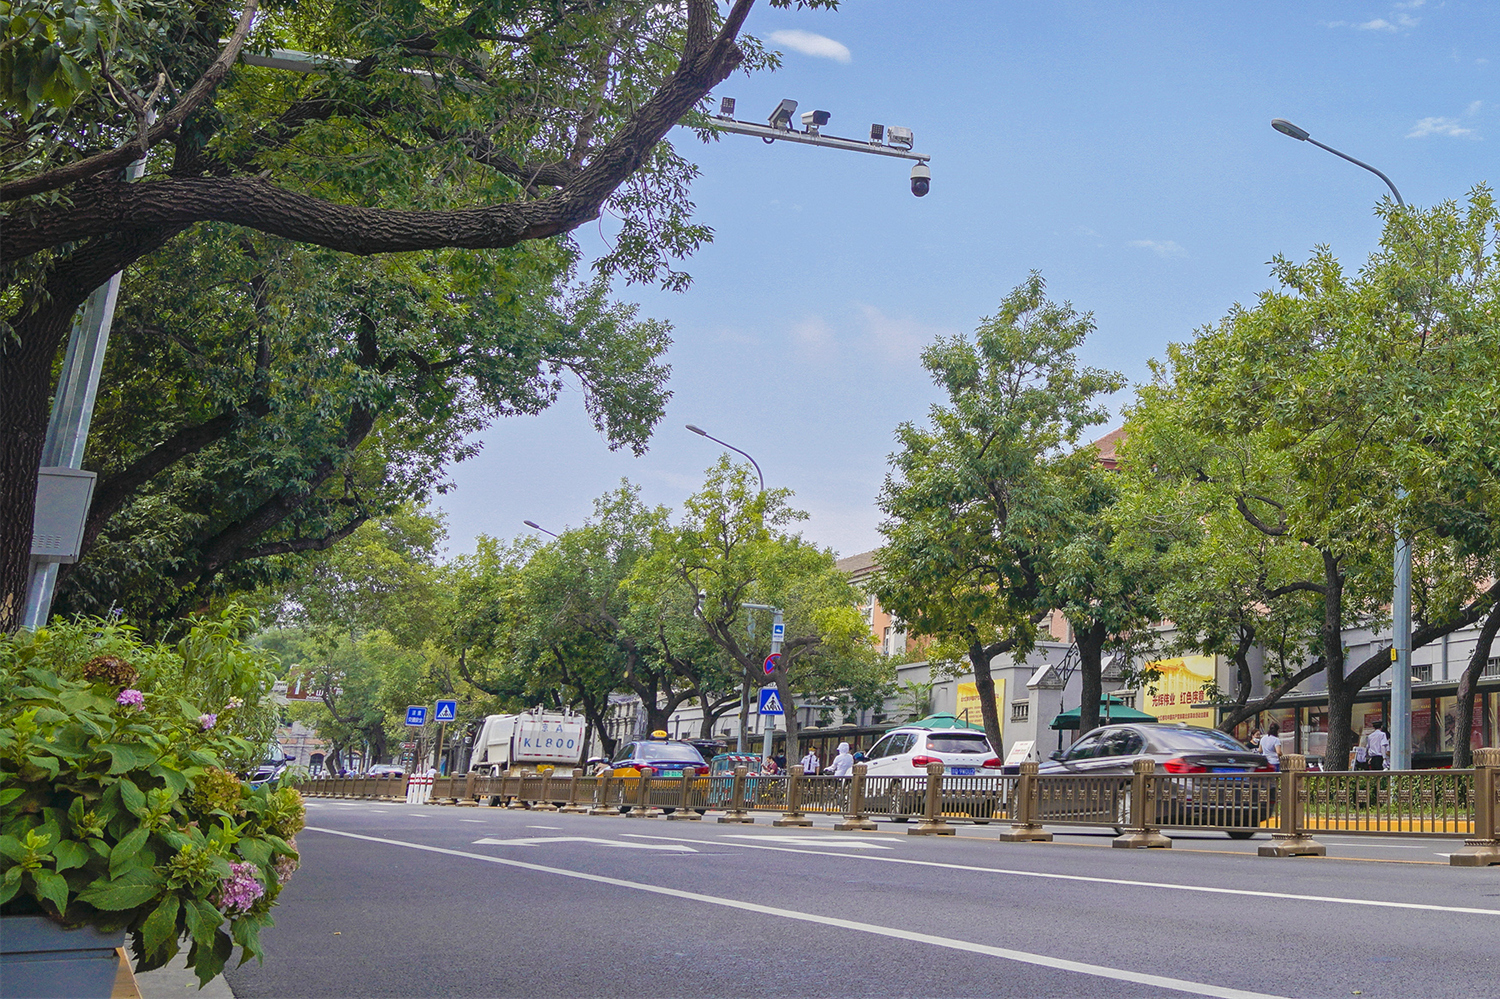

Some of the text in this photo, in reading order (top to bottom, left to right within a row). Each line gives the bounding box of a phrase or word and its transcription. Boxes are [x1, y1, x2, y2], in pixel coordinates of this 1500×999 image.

[1152, 690, 1205, 707] 光辉伟业 红色序章
[523, 737, 575, 749] KL800
